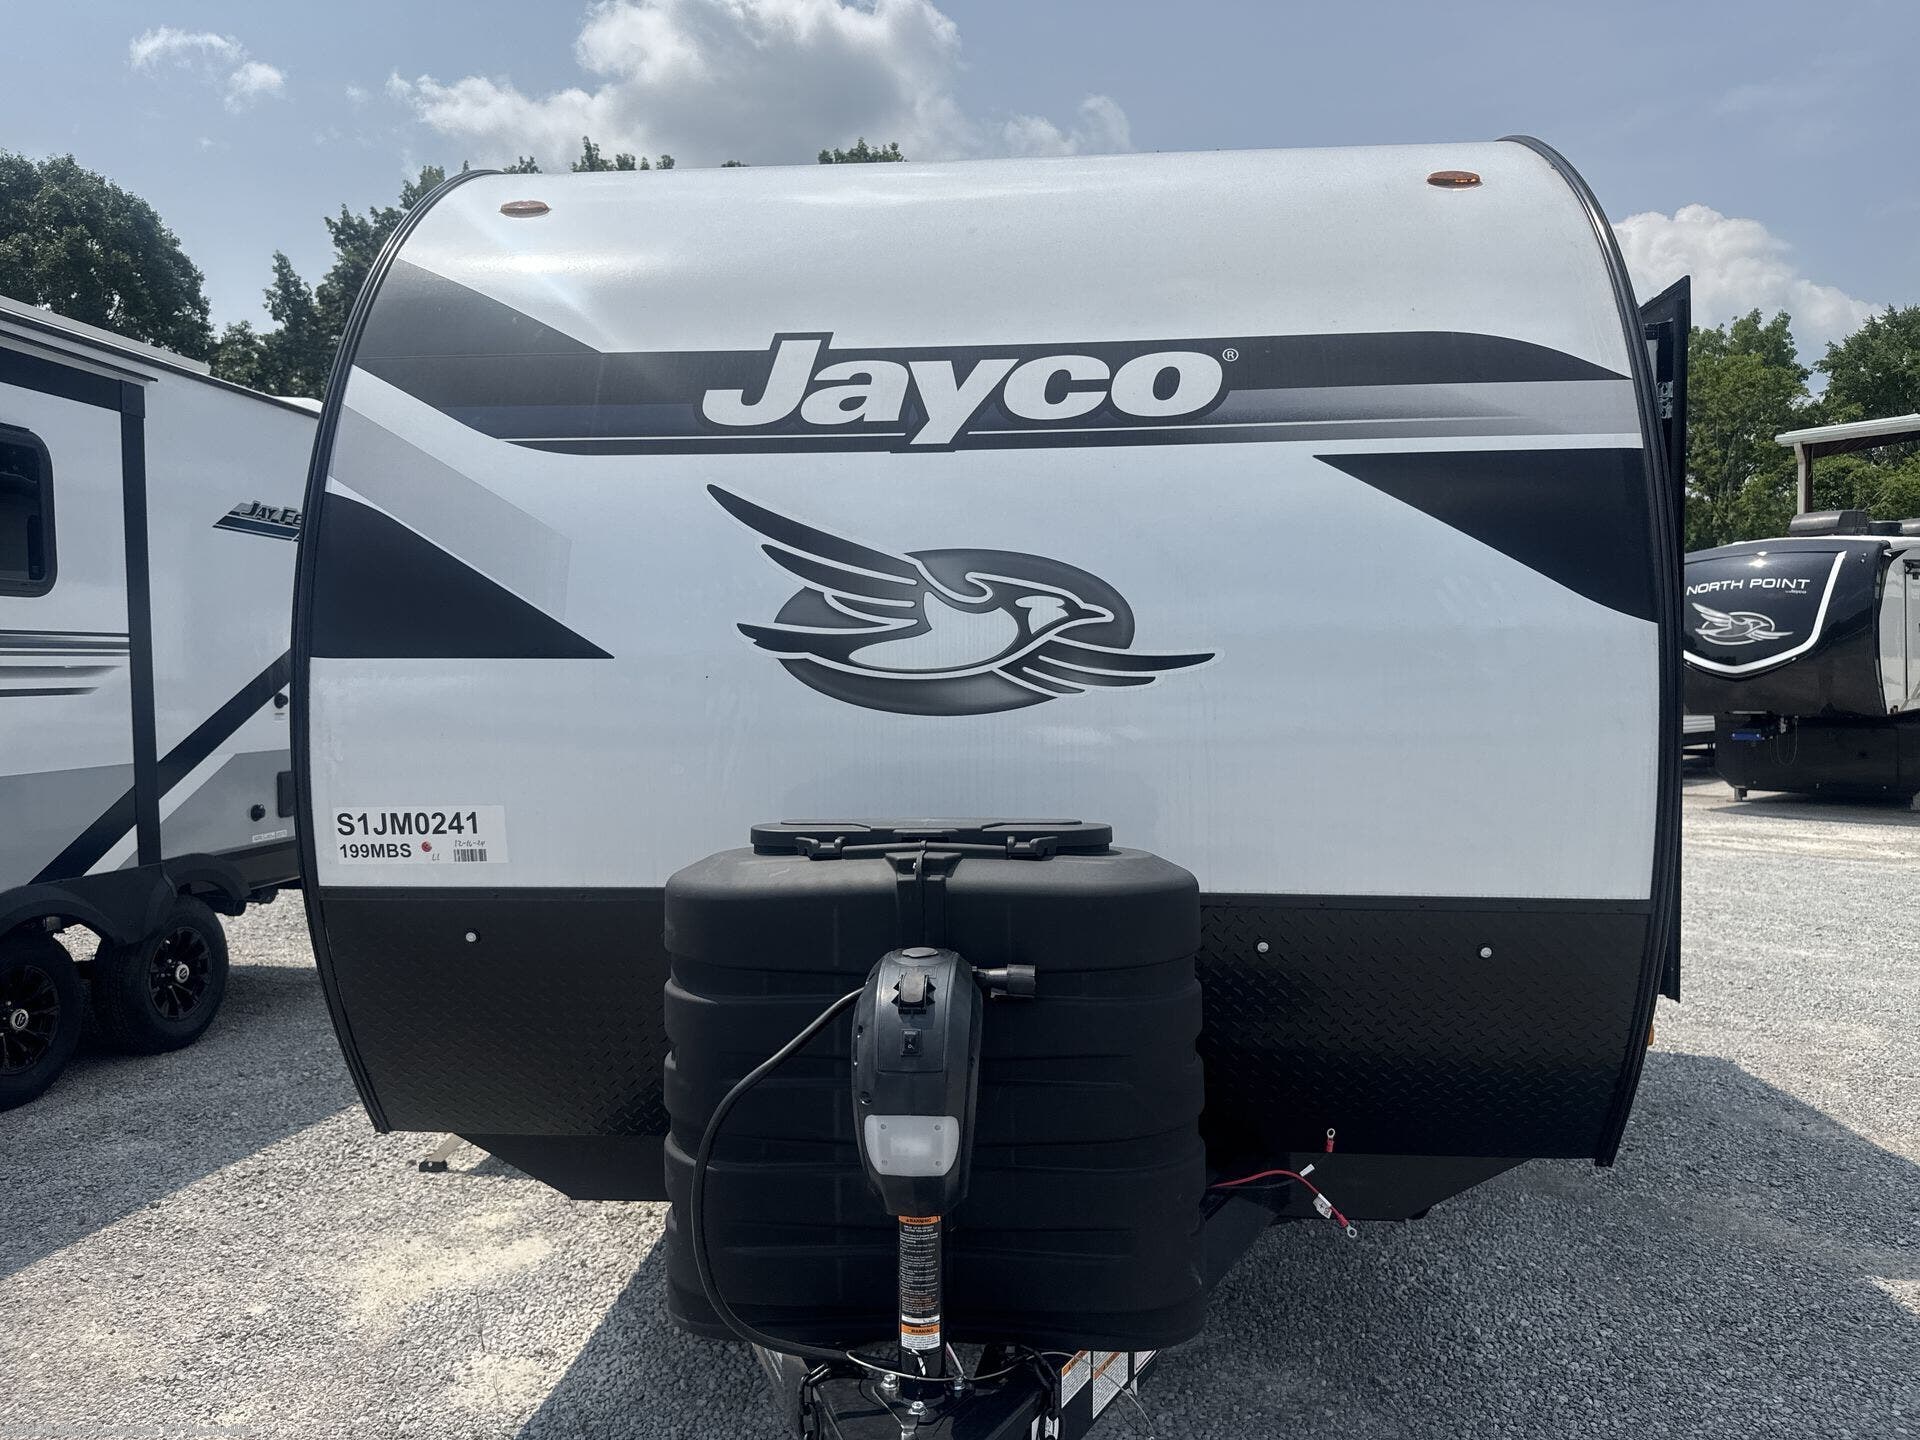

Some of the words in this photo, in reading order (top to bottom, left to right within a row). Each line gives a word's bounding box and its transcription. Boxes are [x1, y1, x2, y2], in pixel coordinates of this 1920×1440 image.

[1686, 579, 1744, 595] NORTH
[1749, 578, 1810, 589] POINT
[337, 812, 478, 835] S1JM0241
[339, 843, 412, 859] 199MBS
[911, 1327, 934, 1335] WARNING
